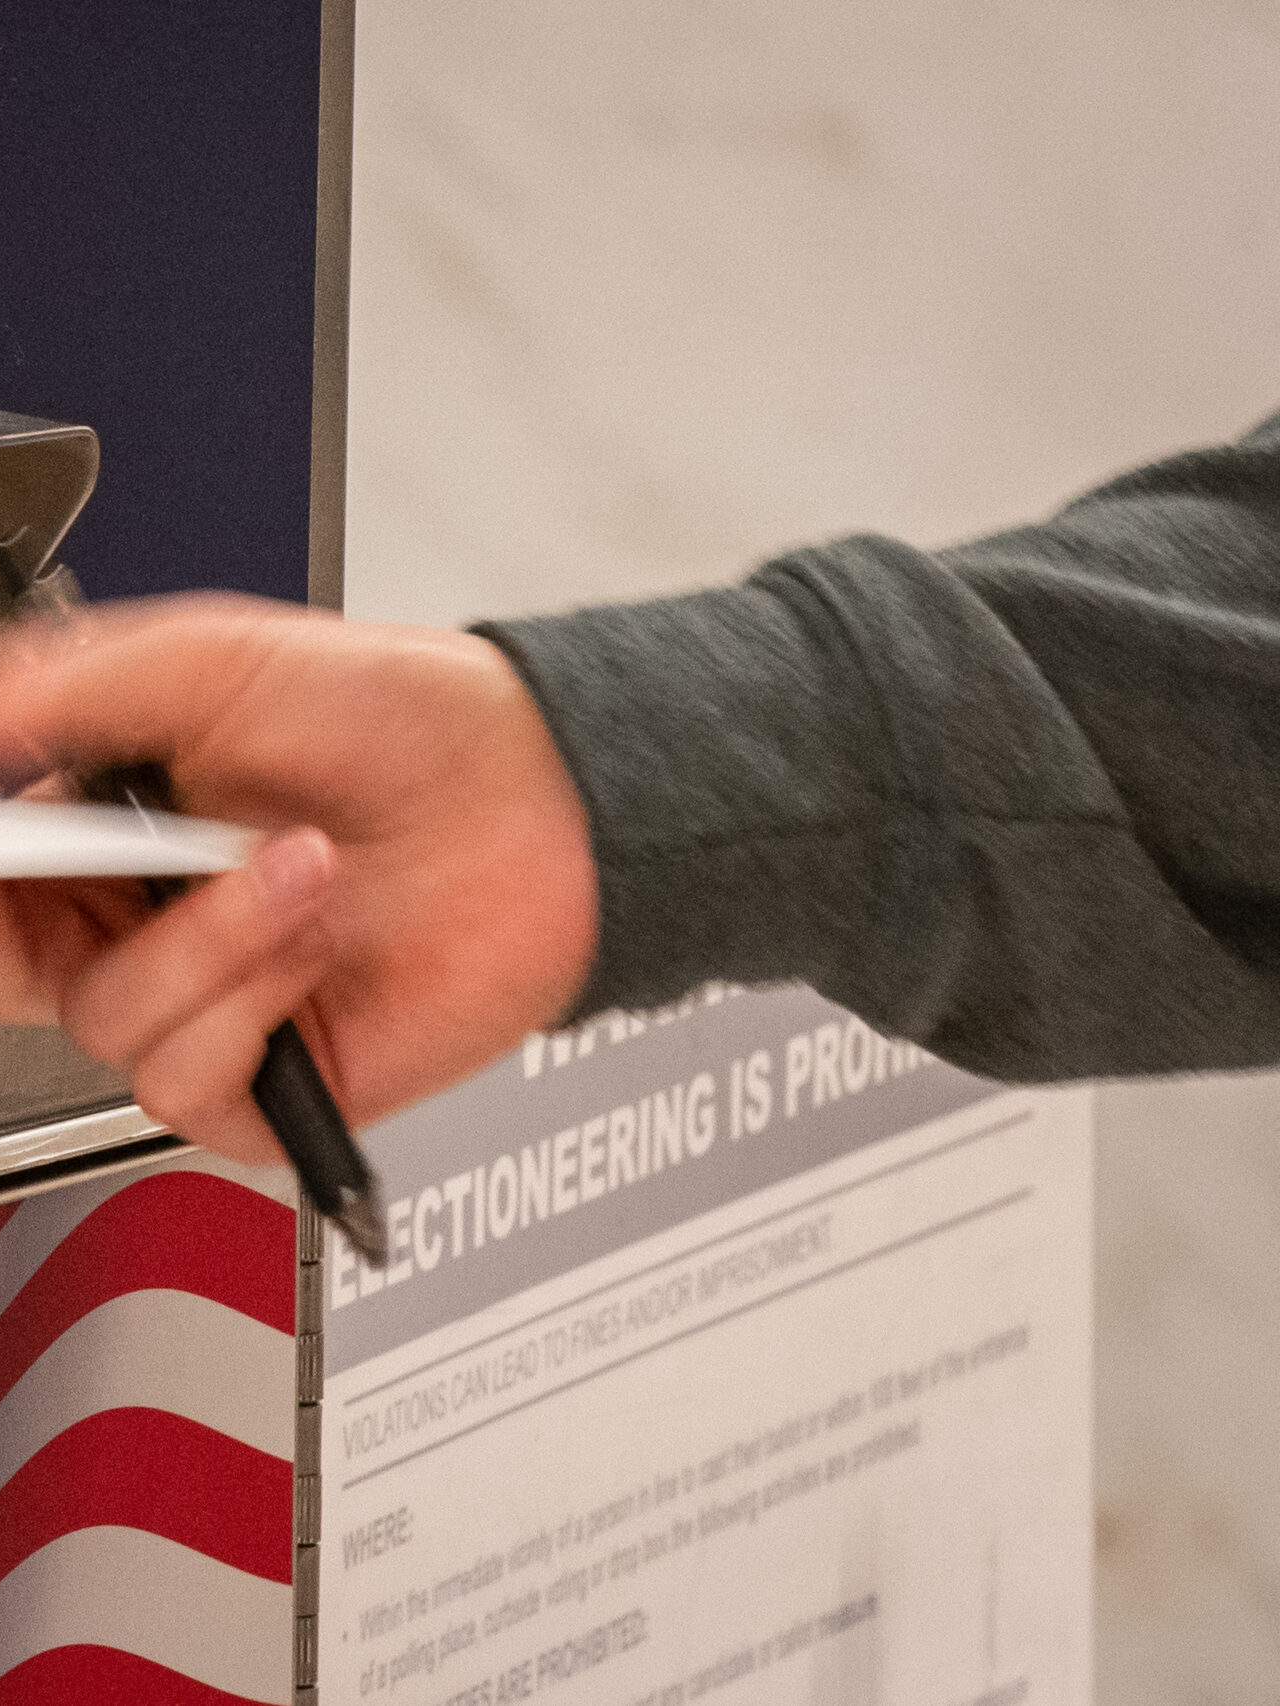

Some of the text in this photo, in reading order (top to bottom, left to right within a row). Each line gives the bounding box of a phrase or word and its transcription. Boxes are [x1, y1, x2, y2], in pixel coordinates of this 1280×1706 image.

[730, 1049, 773, 1141] IS
[342, 1379, 447, 1461] VIOLATIONS
[450, 1359, 490, 1414] CAN
[492, 1338, 539, 1396] LEAD
[542, 1324, 568, 1370] TO
[571, 1302, 620, 1350] FINES
[697, 1211, 833, 1302] IMPRISONMENT
[341, 1504, 415, 1571] WHERE:
[359, 1600, 404, 1642] Within
[407, 1586, 428, 1621] the
[432, 1552, 505, 1608] immediate
[508, 1526, 553, 1574] vicinity
[557, 1513, 574, 1550] of
[587, 1494, 635, 1545] person
[653, 1470, 678, 1507] line
[360, 1658, 376, 1698] of
[376, 1662, 387, 1690] a
[389, 1638, 436, 1691] polling
[483, 1586, 541, 1638] curbside
[546, 1566, 588, 1608] voting
[591, 1557, 605, 1590] or
[608, 1542, 639, 1583] drop
[671, 1518, 693, 1551] the
[697, 1488, 759, 1538] following
[496, 1658, 533, 1705] ARE
[536, 1607, 650, 1693] PROHIBITED:
